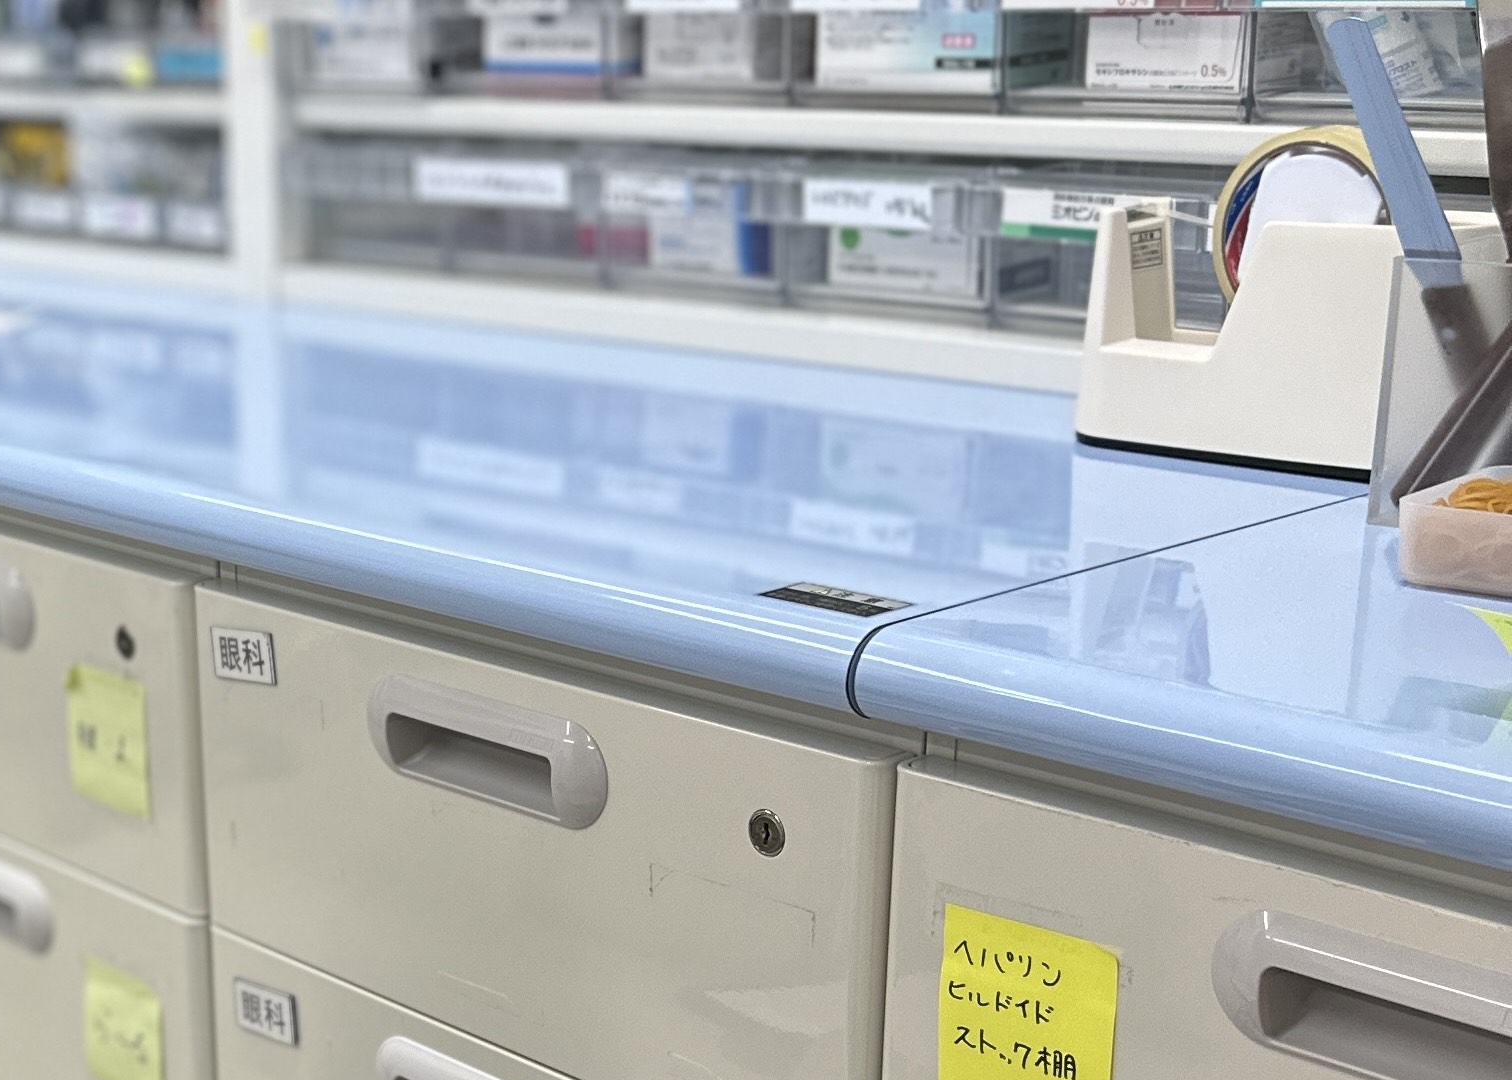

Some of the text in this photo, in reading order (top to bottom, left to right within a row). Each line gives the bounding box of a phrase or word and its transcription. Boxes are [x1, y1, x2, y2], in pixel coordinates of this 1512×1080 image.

[1200, 64, 1227, 78] 0.5%
[219, 636, 265, 676] 眼科
[953, 940, 1061, 987] ヘパリン
[240, 991, 286, 1035] 眼科
[948, 980, 1054, 1025] ヒルドイド
[953, 1026, 1076, 1080] ストック棚
